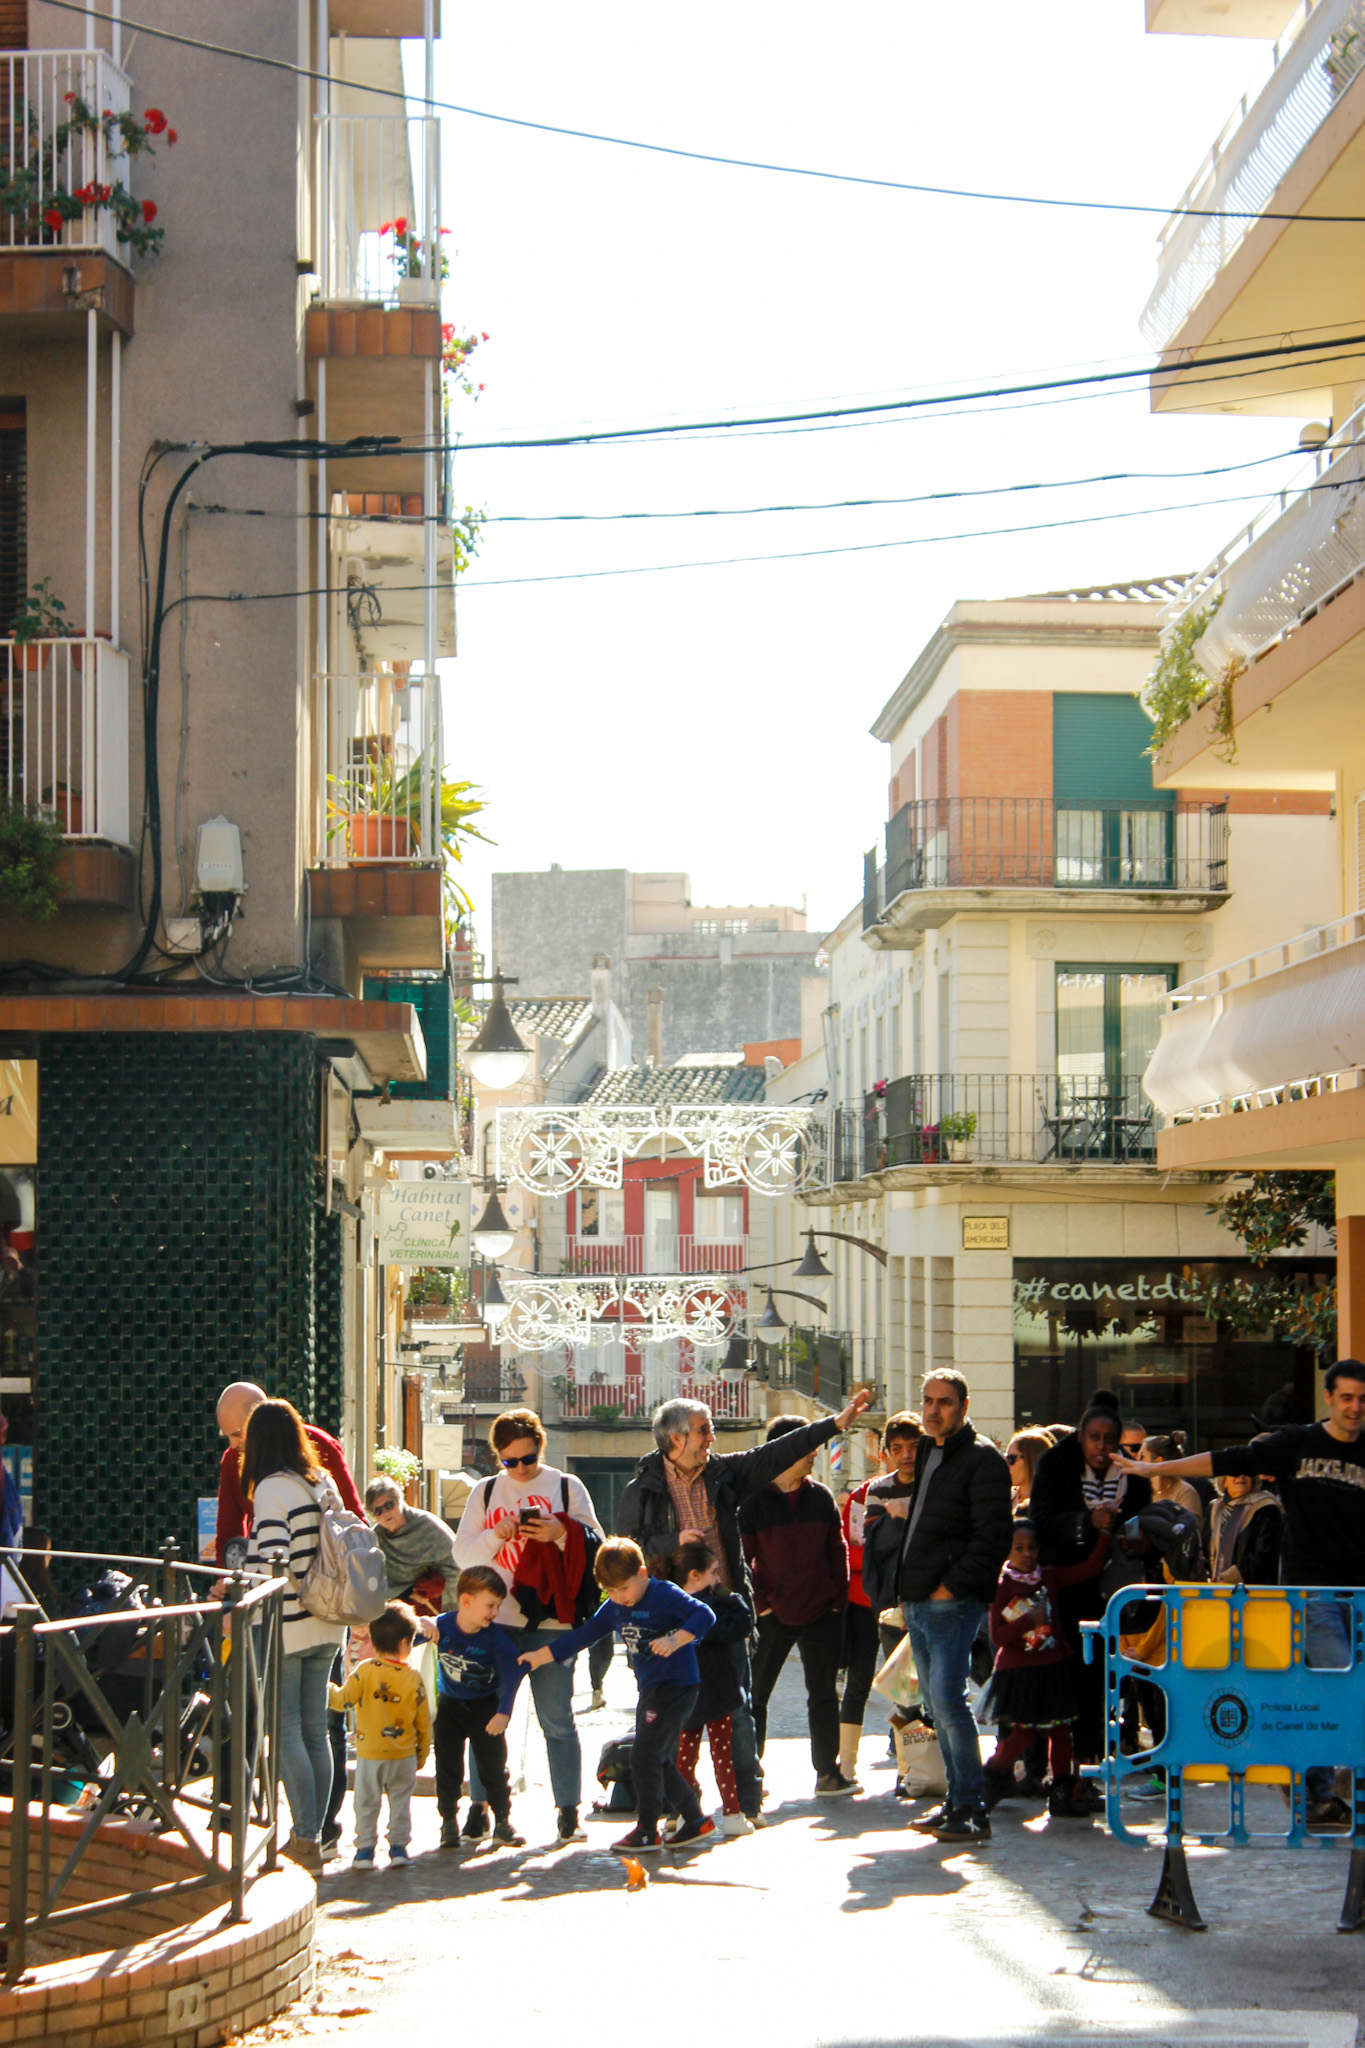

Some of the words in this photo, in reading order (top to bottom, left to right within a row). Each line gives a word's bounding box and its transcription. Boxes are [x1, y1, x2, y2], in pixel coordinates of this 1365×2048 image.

[390, 1187, 463, 1204] Habitat
[400, 1207, 452, 1222] Canet
[964, 1221, 987, 1231] PLAÇA
[990, 1221, 1008, 1230] DELS
[403, 1236, 446, 1247] CLÍNICA
[966, 1235, 1008, 1243] AMERICANOS
[1294, 1703, 1320, 1712] Local
[1261, 1721, 1273, 1731] de
[1275, 1721, 1304, 1731] Canet
[1306, 1721, 1318, 1731] de
[1321, 1721, 1340, 1731] Mar
